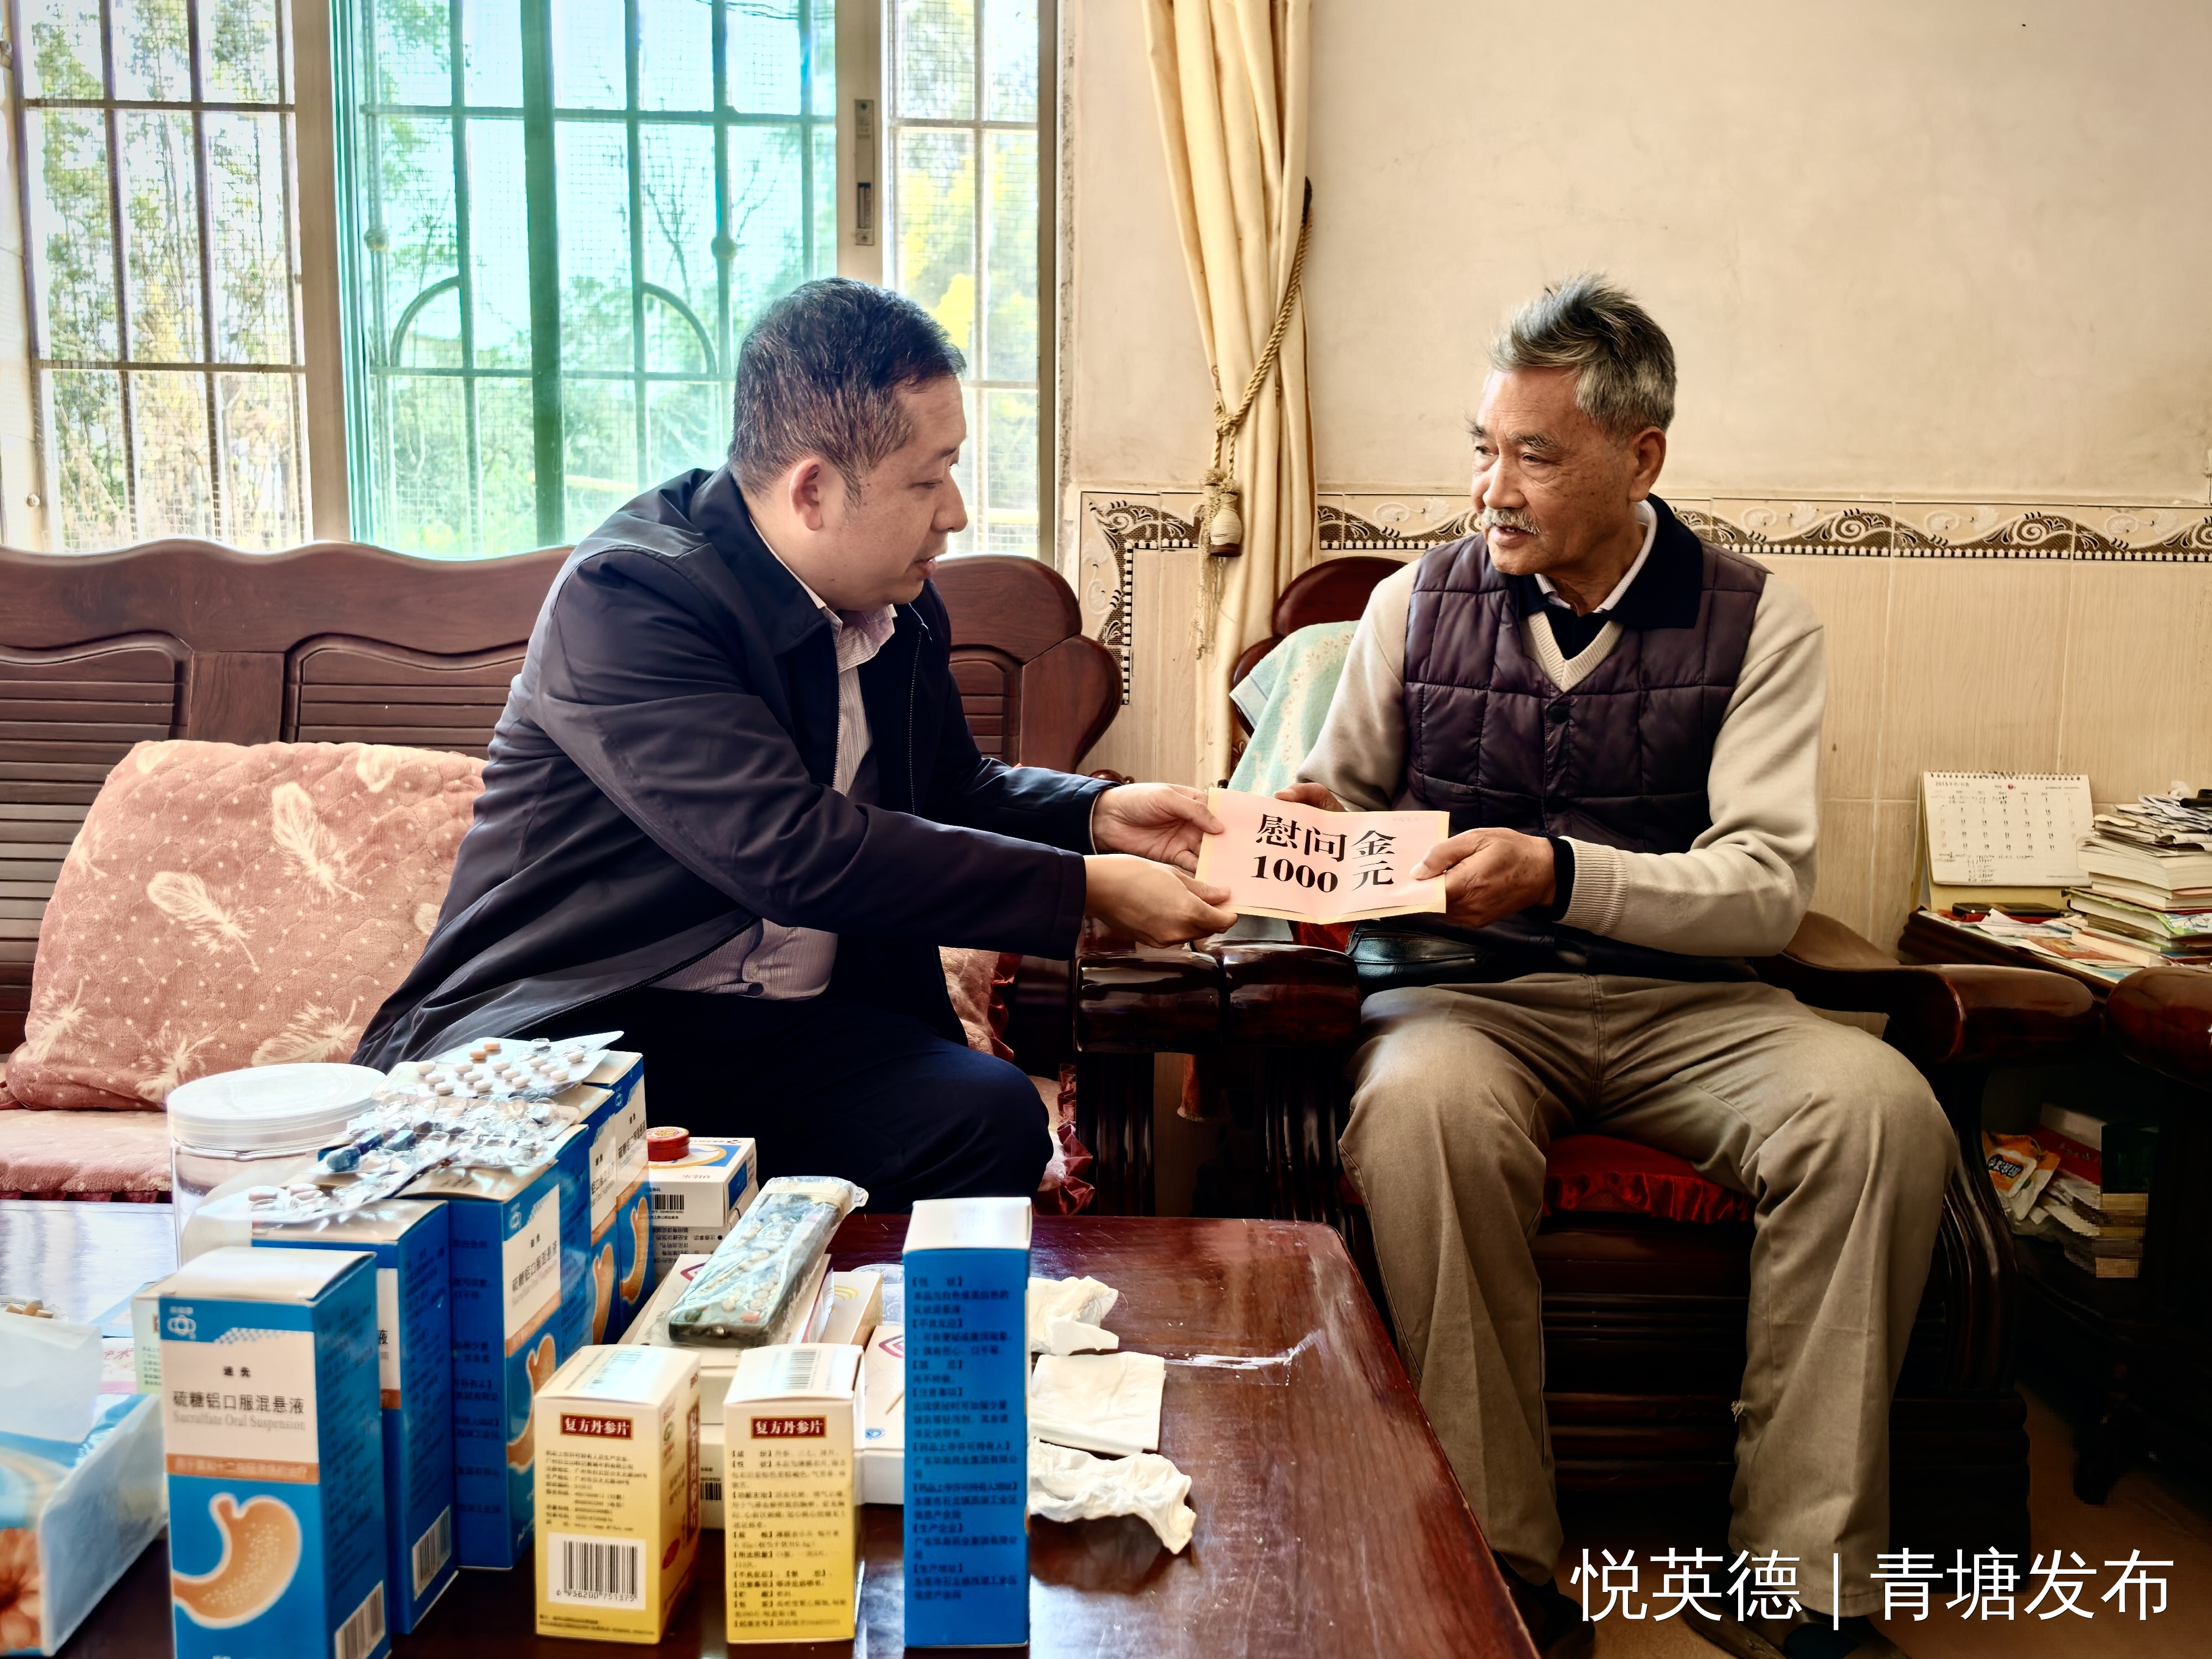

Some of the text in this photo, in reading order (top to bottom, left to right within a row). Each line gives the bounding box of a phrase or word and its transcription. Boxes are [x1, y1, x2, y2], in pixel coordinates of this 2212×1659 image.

[1255, 814, 1396, 862] 慰问金
[173, 1390, 305, 1414] 硫糖铝口服混悬液
[225, 1413, 248, 1426] Oral
[251, 1415, 306, 1431] Suspension
[565, 1417, 630, 1436] 复方丹参片
[755, 1420, 823, 1434] 复方丹参片
